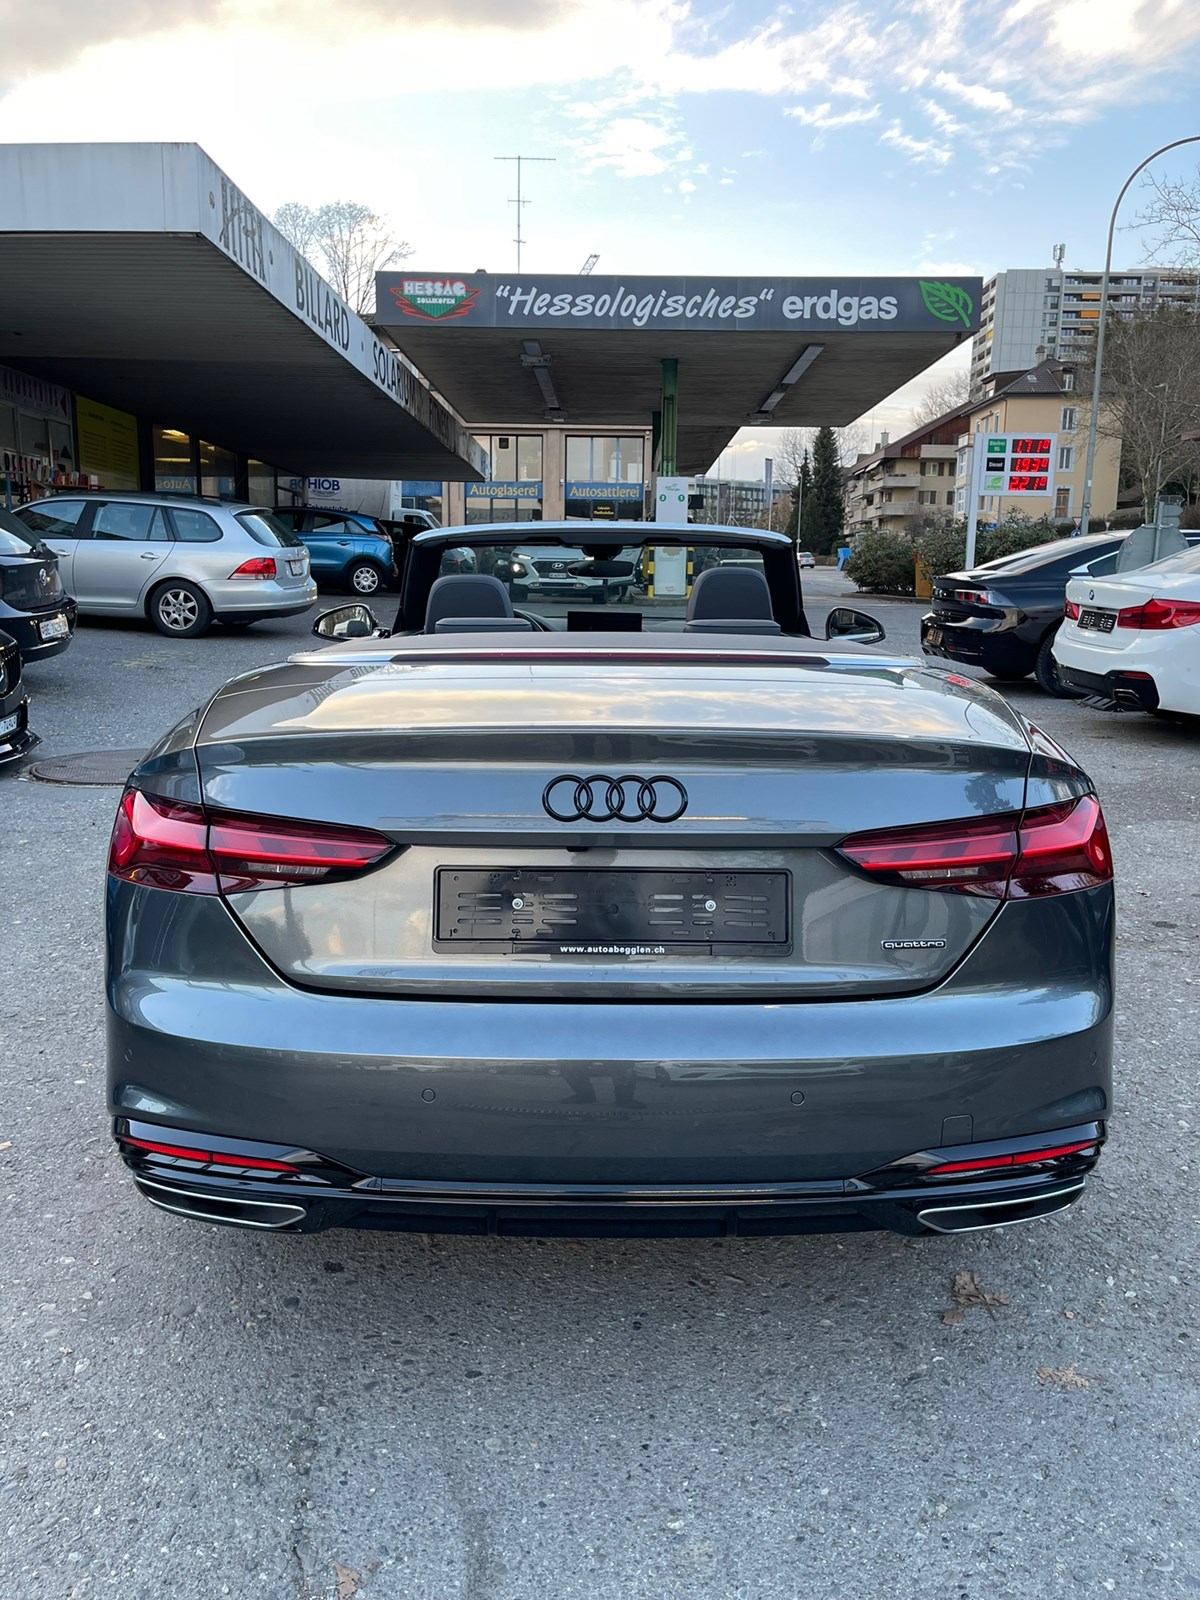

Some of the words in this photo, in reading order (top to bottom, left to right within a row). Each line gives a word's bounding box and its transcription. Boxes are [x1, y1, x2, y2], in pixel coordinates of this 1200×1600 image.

[403, 280, 467, 297] HESSAG
[782, 289, 898, 326] erdgas
[294, 257, 350, 352] BILLARD
[373, 340, 417, 417] SOLARIUM
[307, 478, 341, 491] HIOB
[470, 484, 539, 498] Autoglaserei
[569, 485, 640, 498] Autosattlerei
[559, 945, 665, 955] www.autoabegglen.ch
[884, 940, 945, 949] quattro
